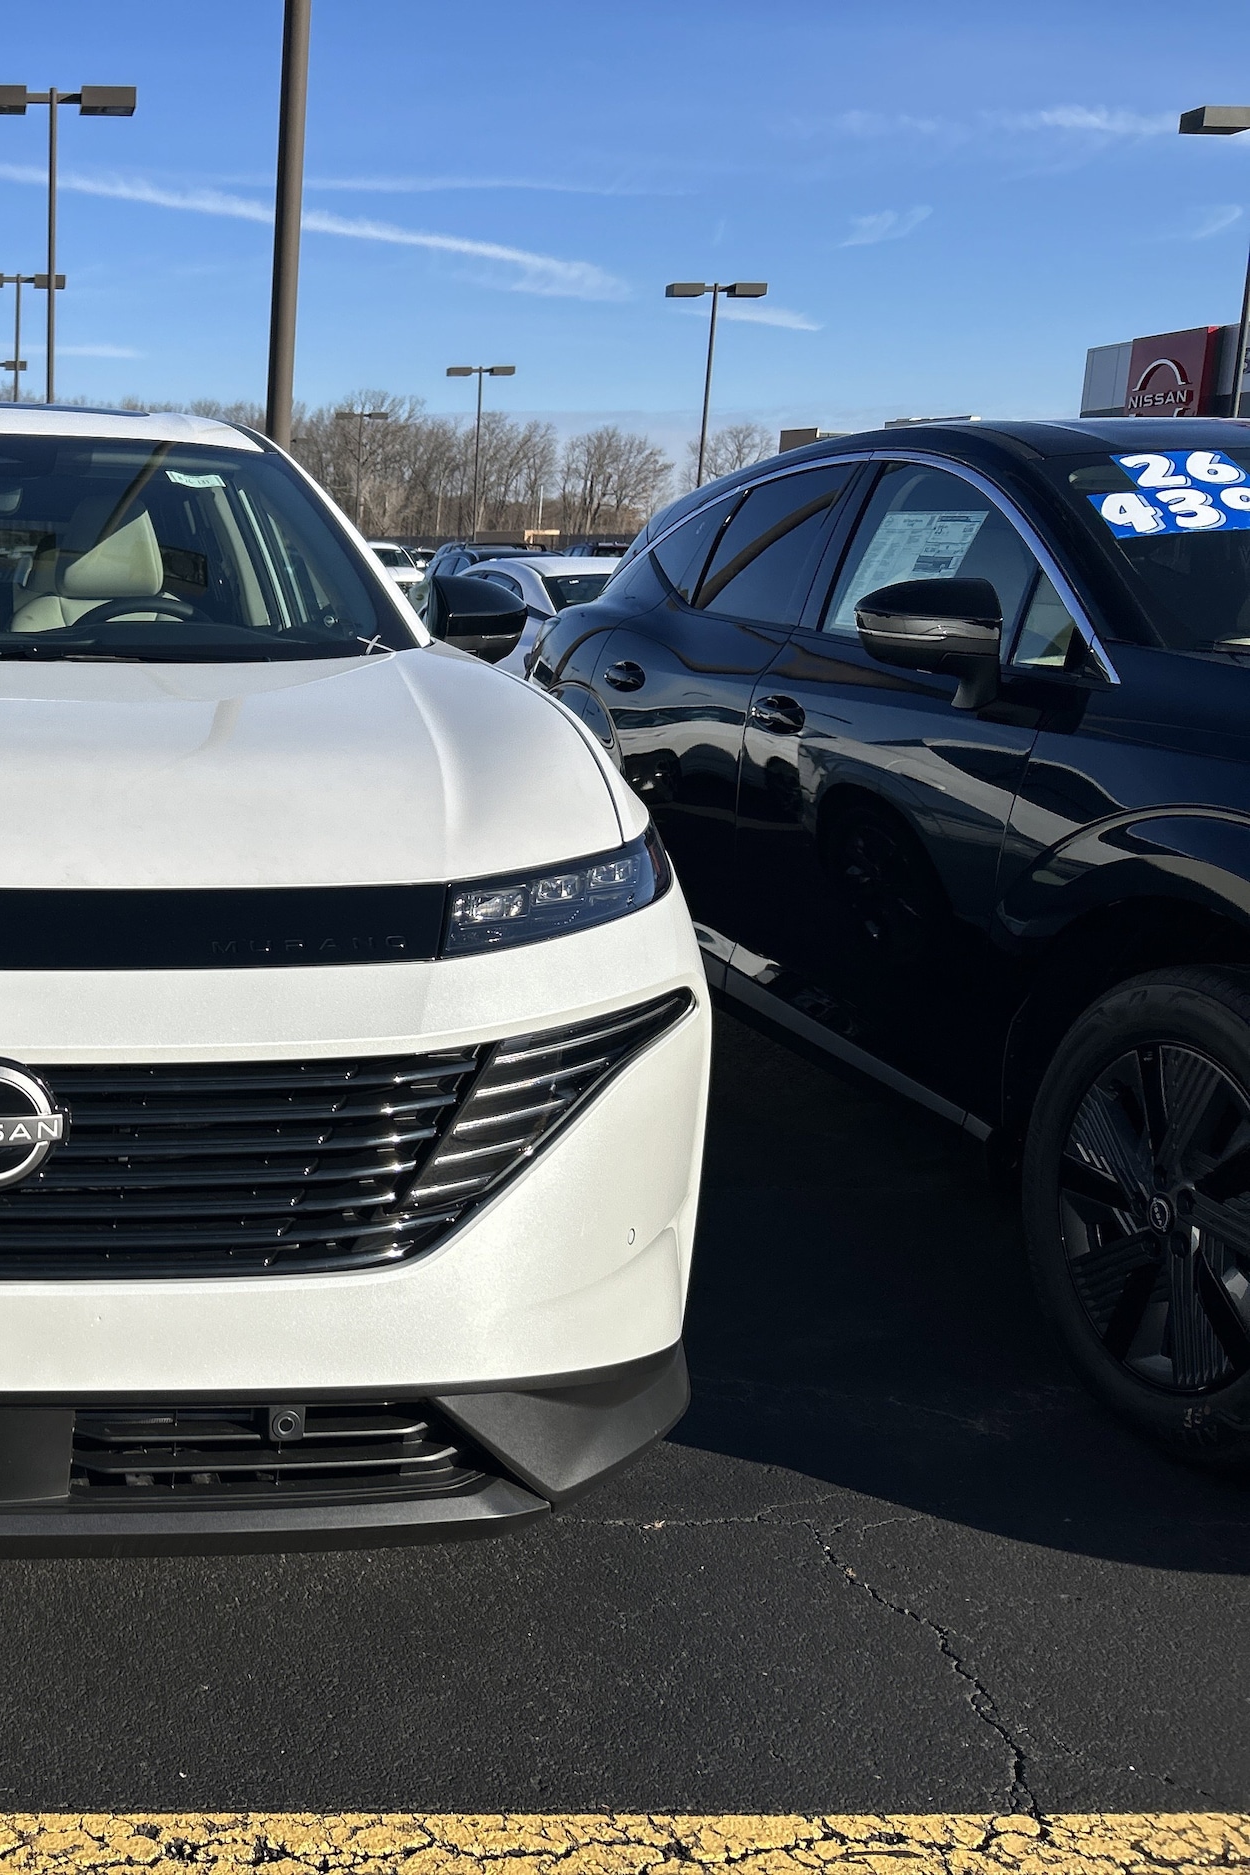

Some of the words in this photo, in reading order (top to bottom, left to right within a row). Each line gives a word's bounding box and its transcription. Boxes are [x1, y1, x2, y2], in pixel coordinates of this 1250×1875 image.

[1128, 390, 1187, 409] NISSAN
[1119, 451, 1246, 488] 26
[211, 935, 407, 954] MURANO
